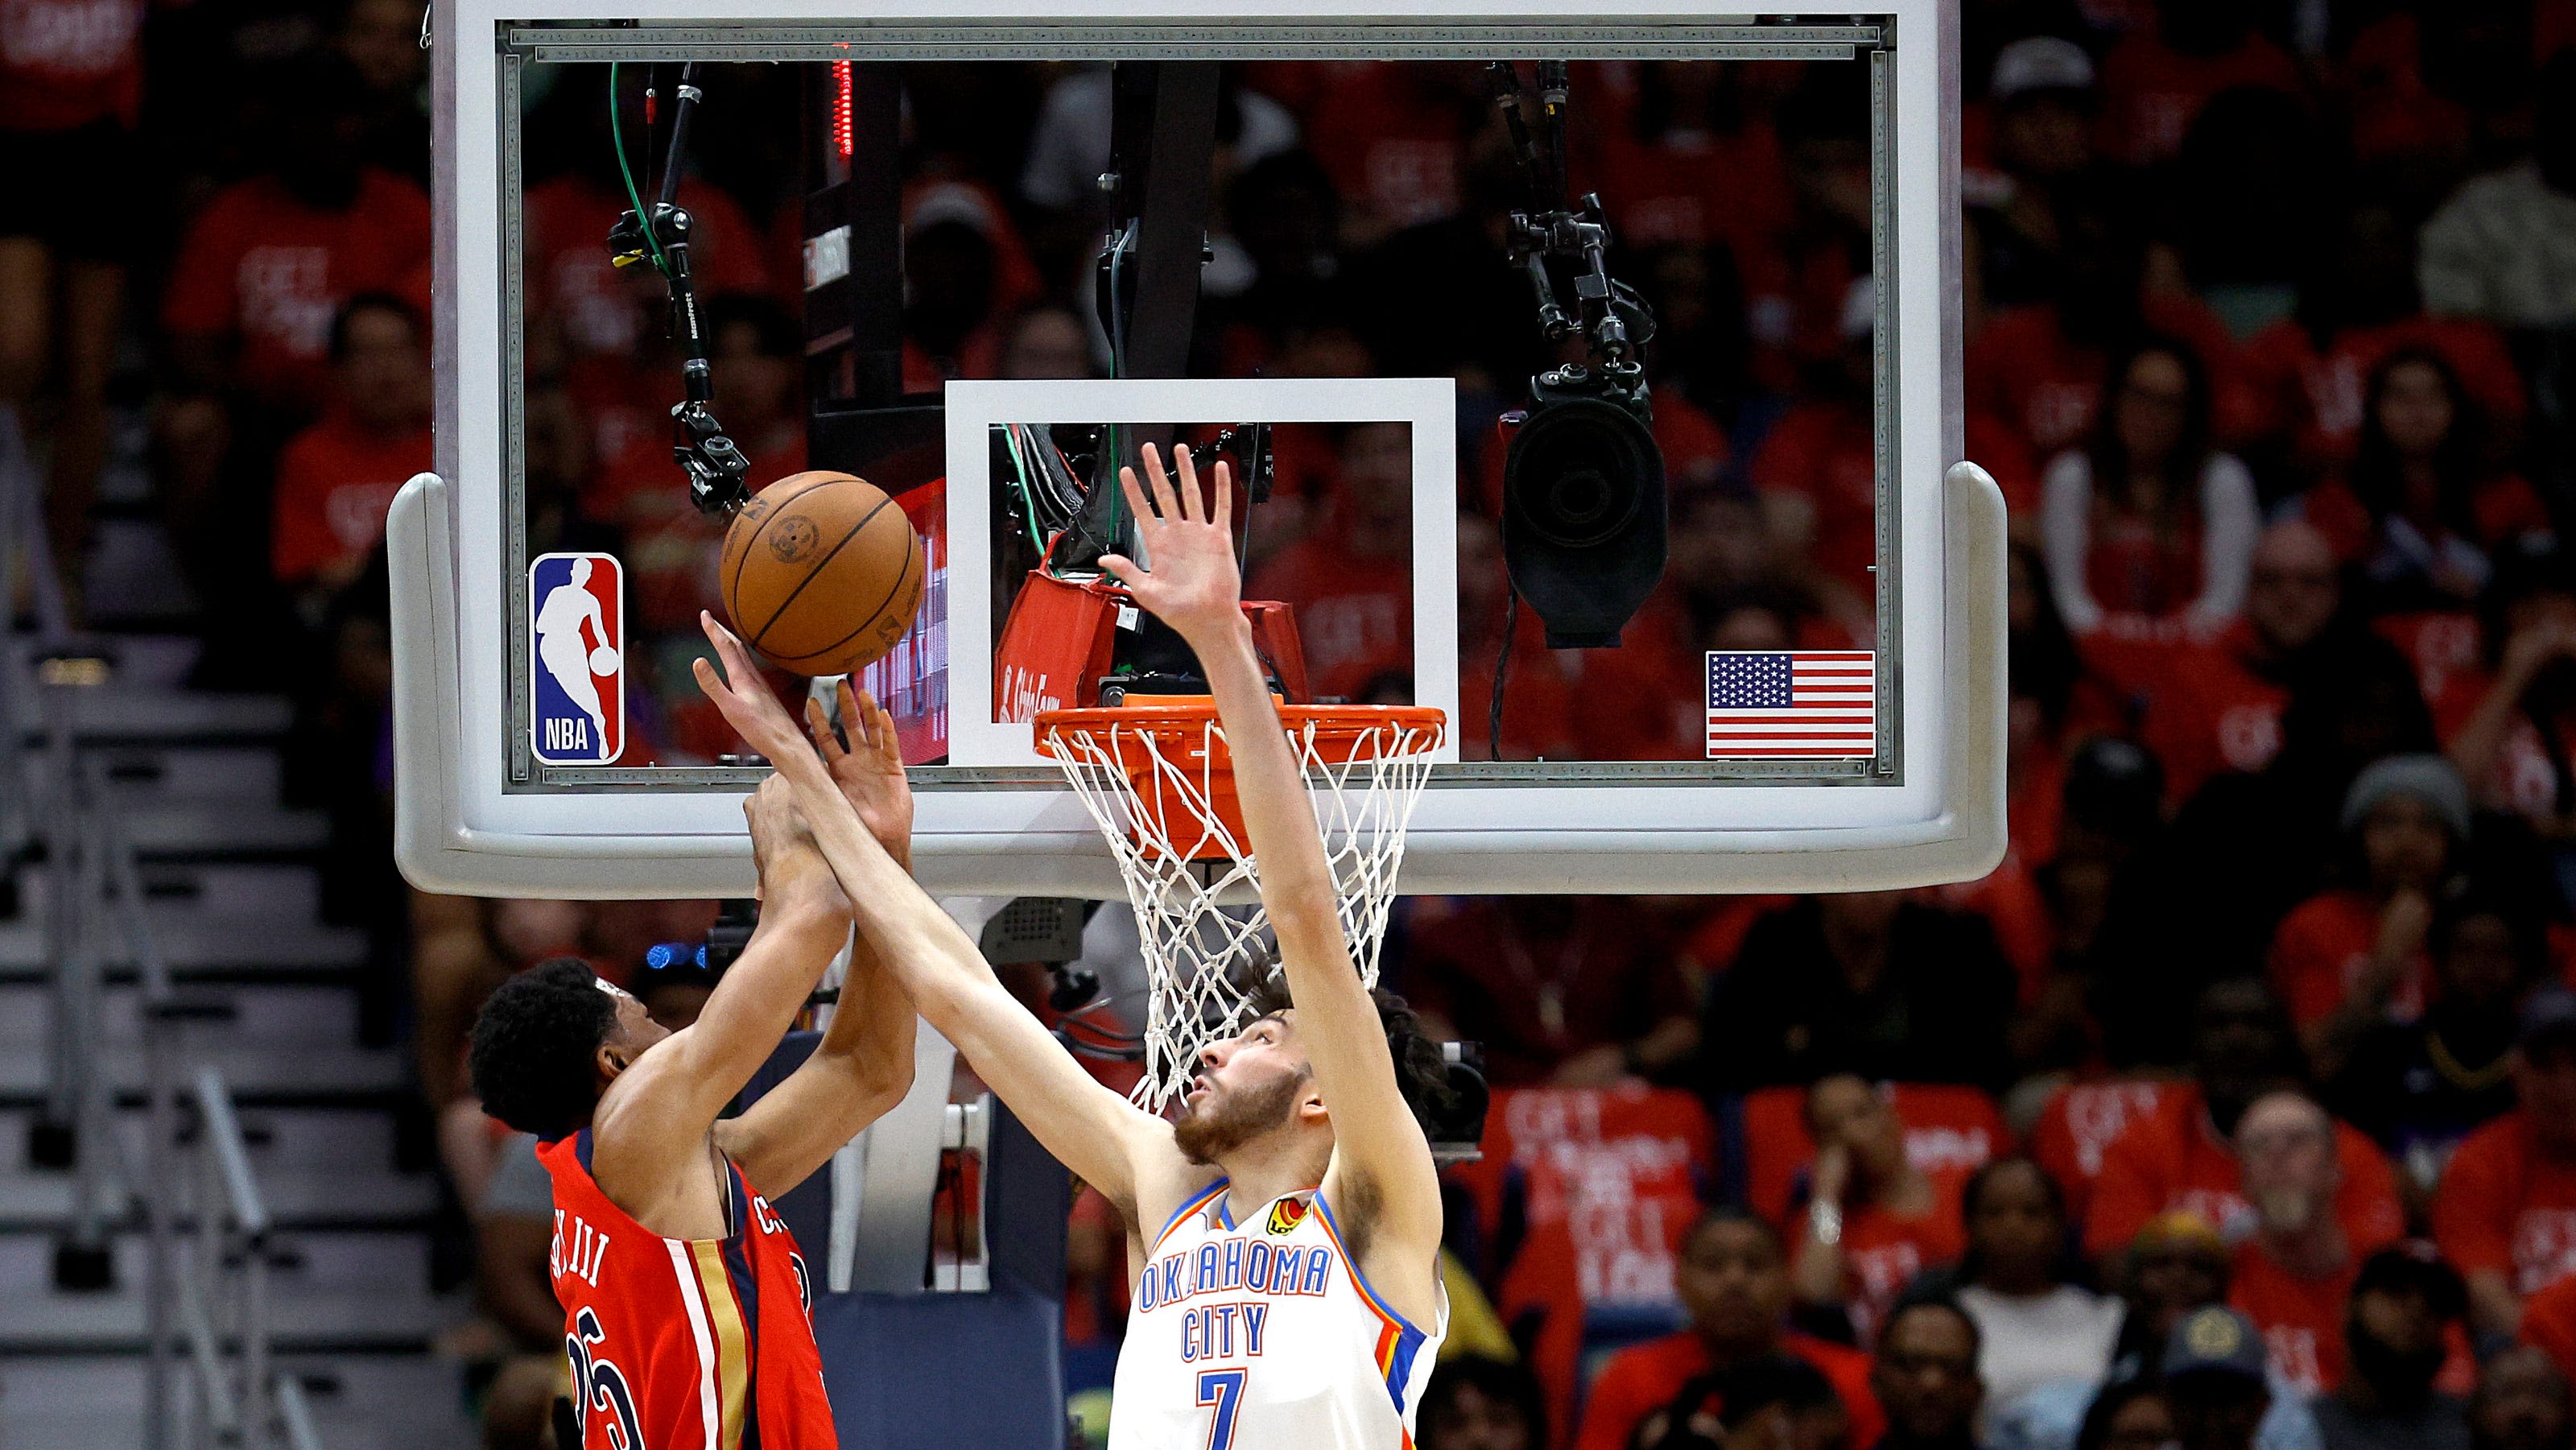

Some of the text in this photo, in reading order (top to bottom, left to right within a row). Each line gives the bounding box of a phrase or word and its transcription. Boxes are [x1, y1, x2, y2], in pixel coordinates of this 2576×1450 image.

[545, 717, 588, 750] NBA
[568, 1216, 610, 1288] III
[1139, 1237, 1334, 1313] OKLAHOMA
[1181, 1302, 1269, 1363] CITY
[1195, 1367, 1248, 1449] 7
